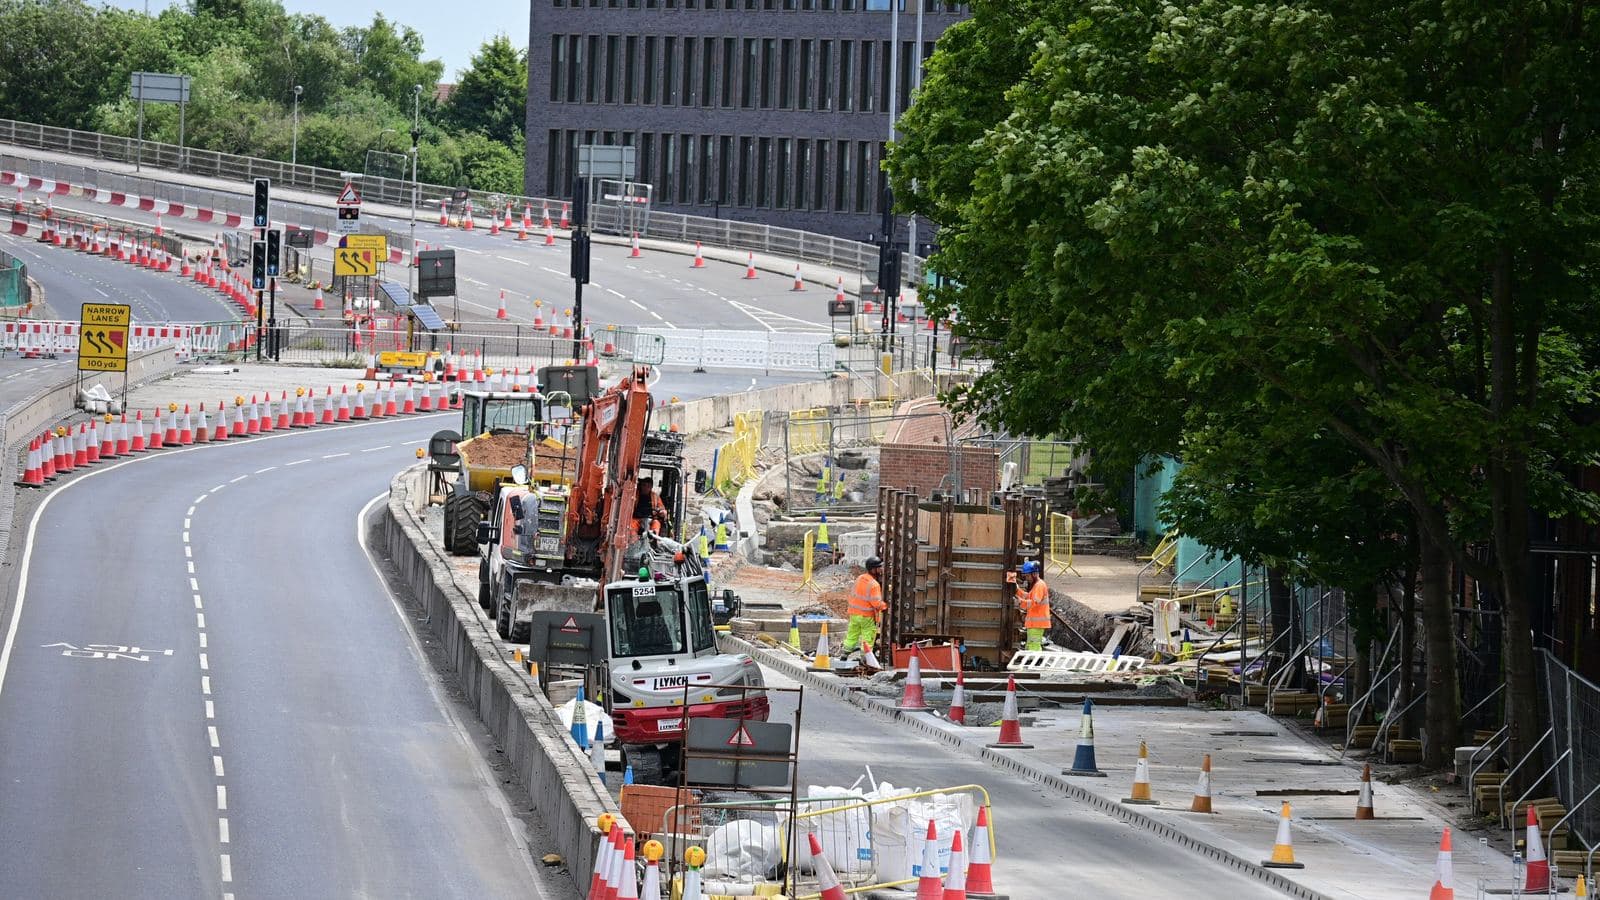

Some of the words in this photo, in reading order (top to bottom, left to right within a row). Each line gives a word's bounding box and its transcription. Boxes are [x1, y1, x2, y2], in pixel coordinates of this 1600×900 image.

[86, 307, 125, 315] NARROW
[91, 315, 120, 323] LANES
[634, 587, 654, 595] 5254
[659, 676, 688, 687] LYNCH
